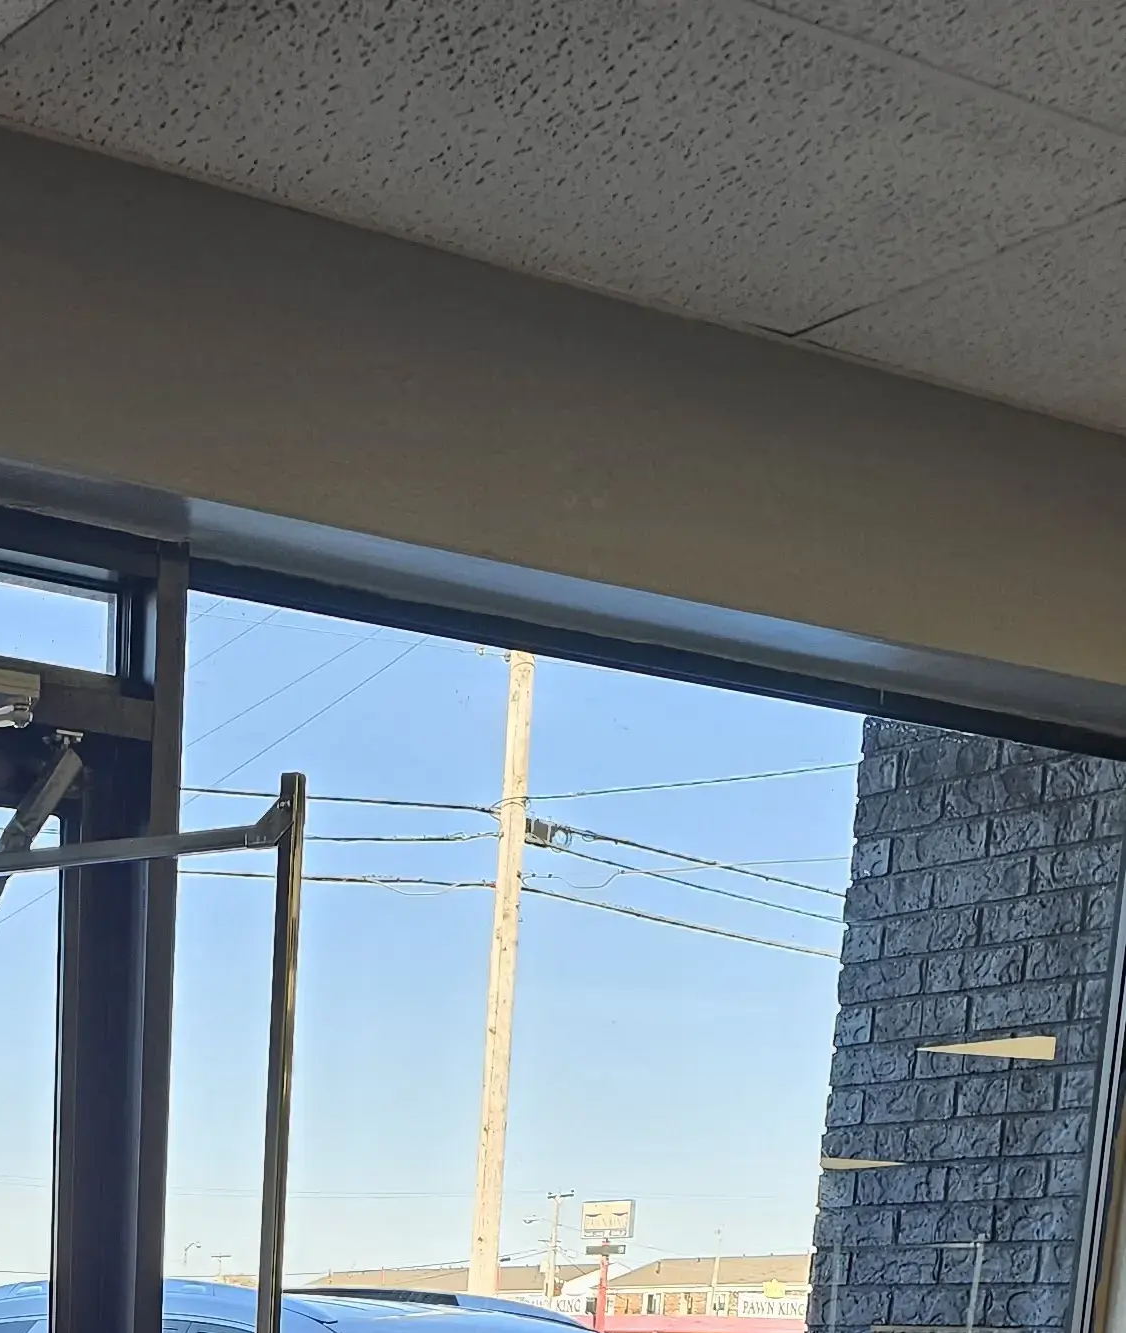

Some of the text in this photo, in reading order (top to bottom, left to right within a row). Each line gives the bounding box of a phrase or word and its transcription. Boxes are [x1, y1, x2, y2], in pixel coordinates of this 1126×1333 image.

[556, 1299, 581, 1312] KING
[742, 1300, 805, 1316] PAWN KING
